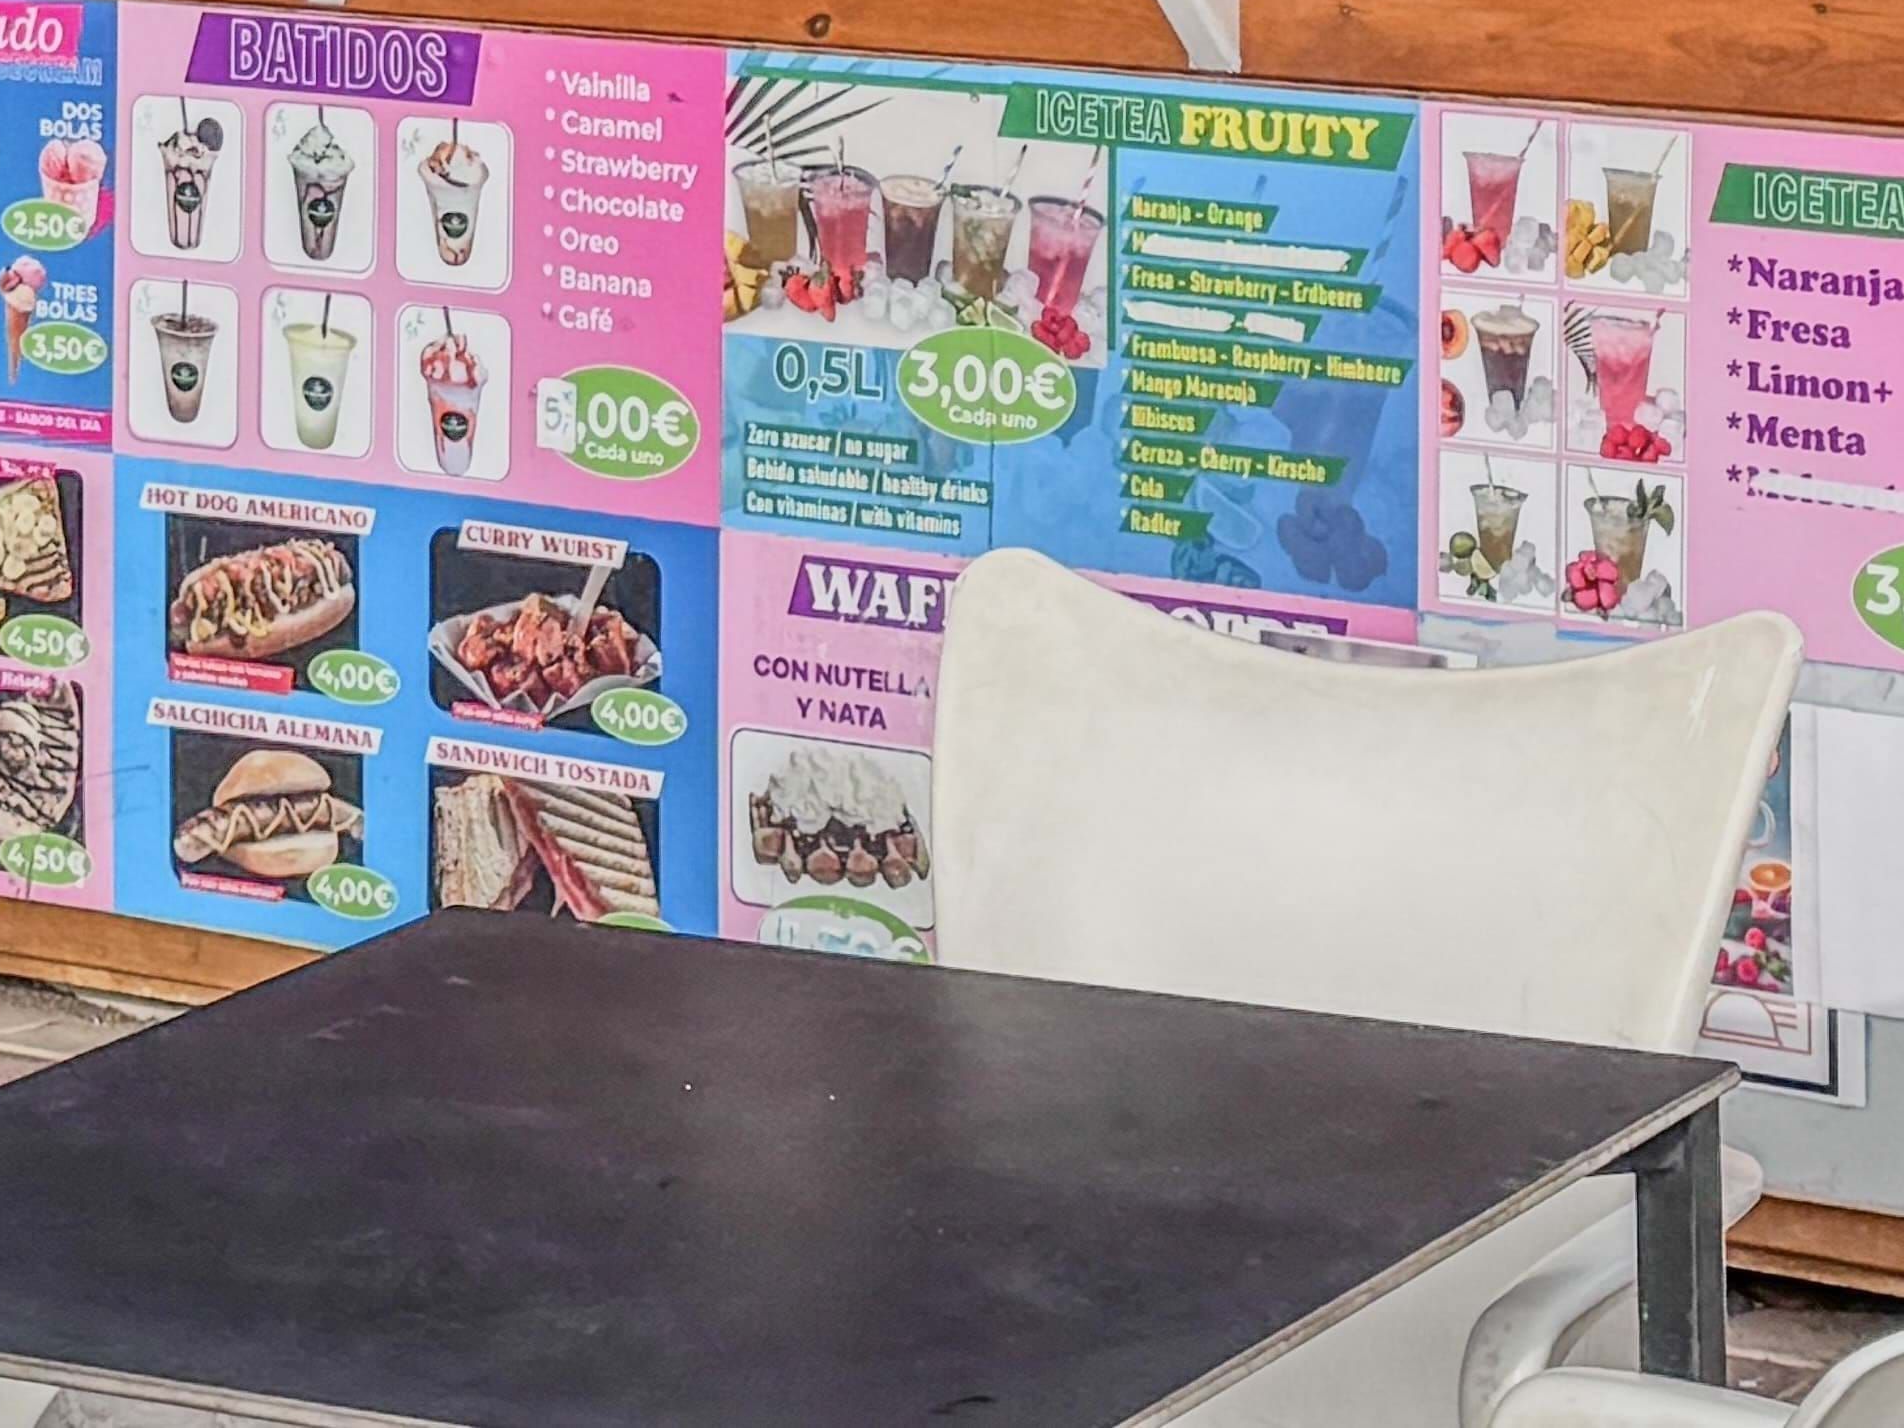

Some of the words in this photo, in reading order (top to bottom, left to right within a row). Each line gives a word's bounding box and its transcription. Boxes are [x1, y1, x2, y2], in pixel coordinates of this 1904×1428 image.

[228, 17, 448, 98] BATIDOS
[561, 71, 652, 104] Vainilla
[61, 101, 103, 122] DOS
[561, 112, 663, 143] Caramel
[1035, 90, 1171, 144] ICETEA
[1178, 102, 1380, 162] FRUITY
[39, 119, 103, 141] BOLAS
[560, 148, 698, 189] Strawberry
[560, 189, 685, 224] Chocolate
[12, 209, 88, 243] 2,50€
[559, 227, 620, 257] Oreo
[51, 281, 99, 304] TRES
[559, 265, 653, 300] Banana
[35, 299, 98, 323] BOLAS
[558, 303, 614, 335] Café
[1745, 309, 1853, 350] Fresa
[30, 332, 104, 364] 3,50€
[773, 342, 884, 404] 0,5L
[906, 348, 1068, 410] 3,00€
[1746, 363, 1894, 406] Limon+
[1001, 410, 1038, 430] uno
[1745, 415, 1868, 457] Menta
[584, 441, 627, 463] Cada
[630, 448, 665, 467] uno
[145, 486, 190, 510] HOT
[195, 491, 240, 515] DOG
[245, 498, 369, 531] AMERICANO
[464, 523, 535, 548] CURRY
[540, 534, 619, 562] WURST
[314, 658, 395, 695] 4,00€
[752, 654, 810, 684] CON
[814, 663, 932, 699] NUTELLA
[152, 702, 270, 735] SALCHICHA
[273, 719, 375, 749] ALEMANA
[597, 700, 680, 734] 4,00€
[795, 697, 813, 720] Y
[818, 700, 888, 731] NATA
[435, 740, 550, 777] SANDWICH
[554, 760, 652, 793] TOSTADA
[314, 874, 394, 910] 4,00€
